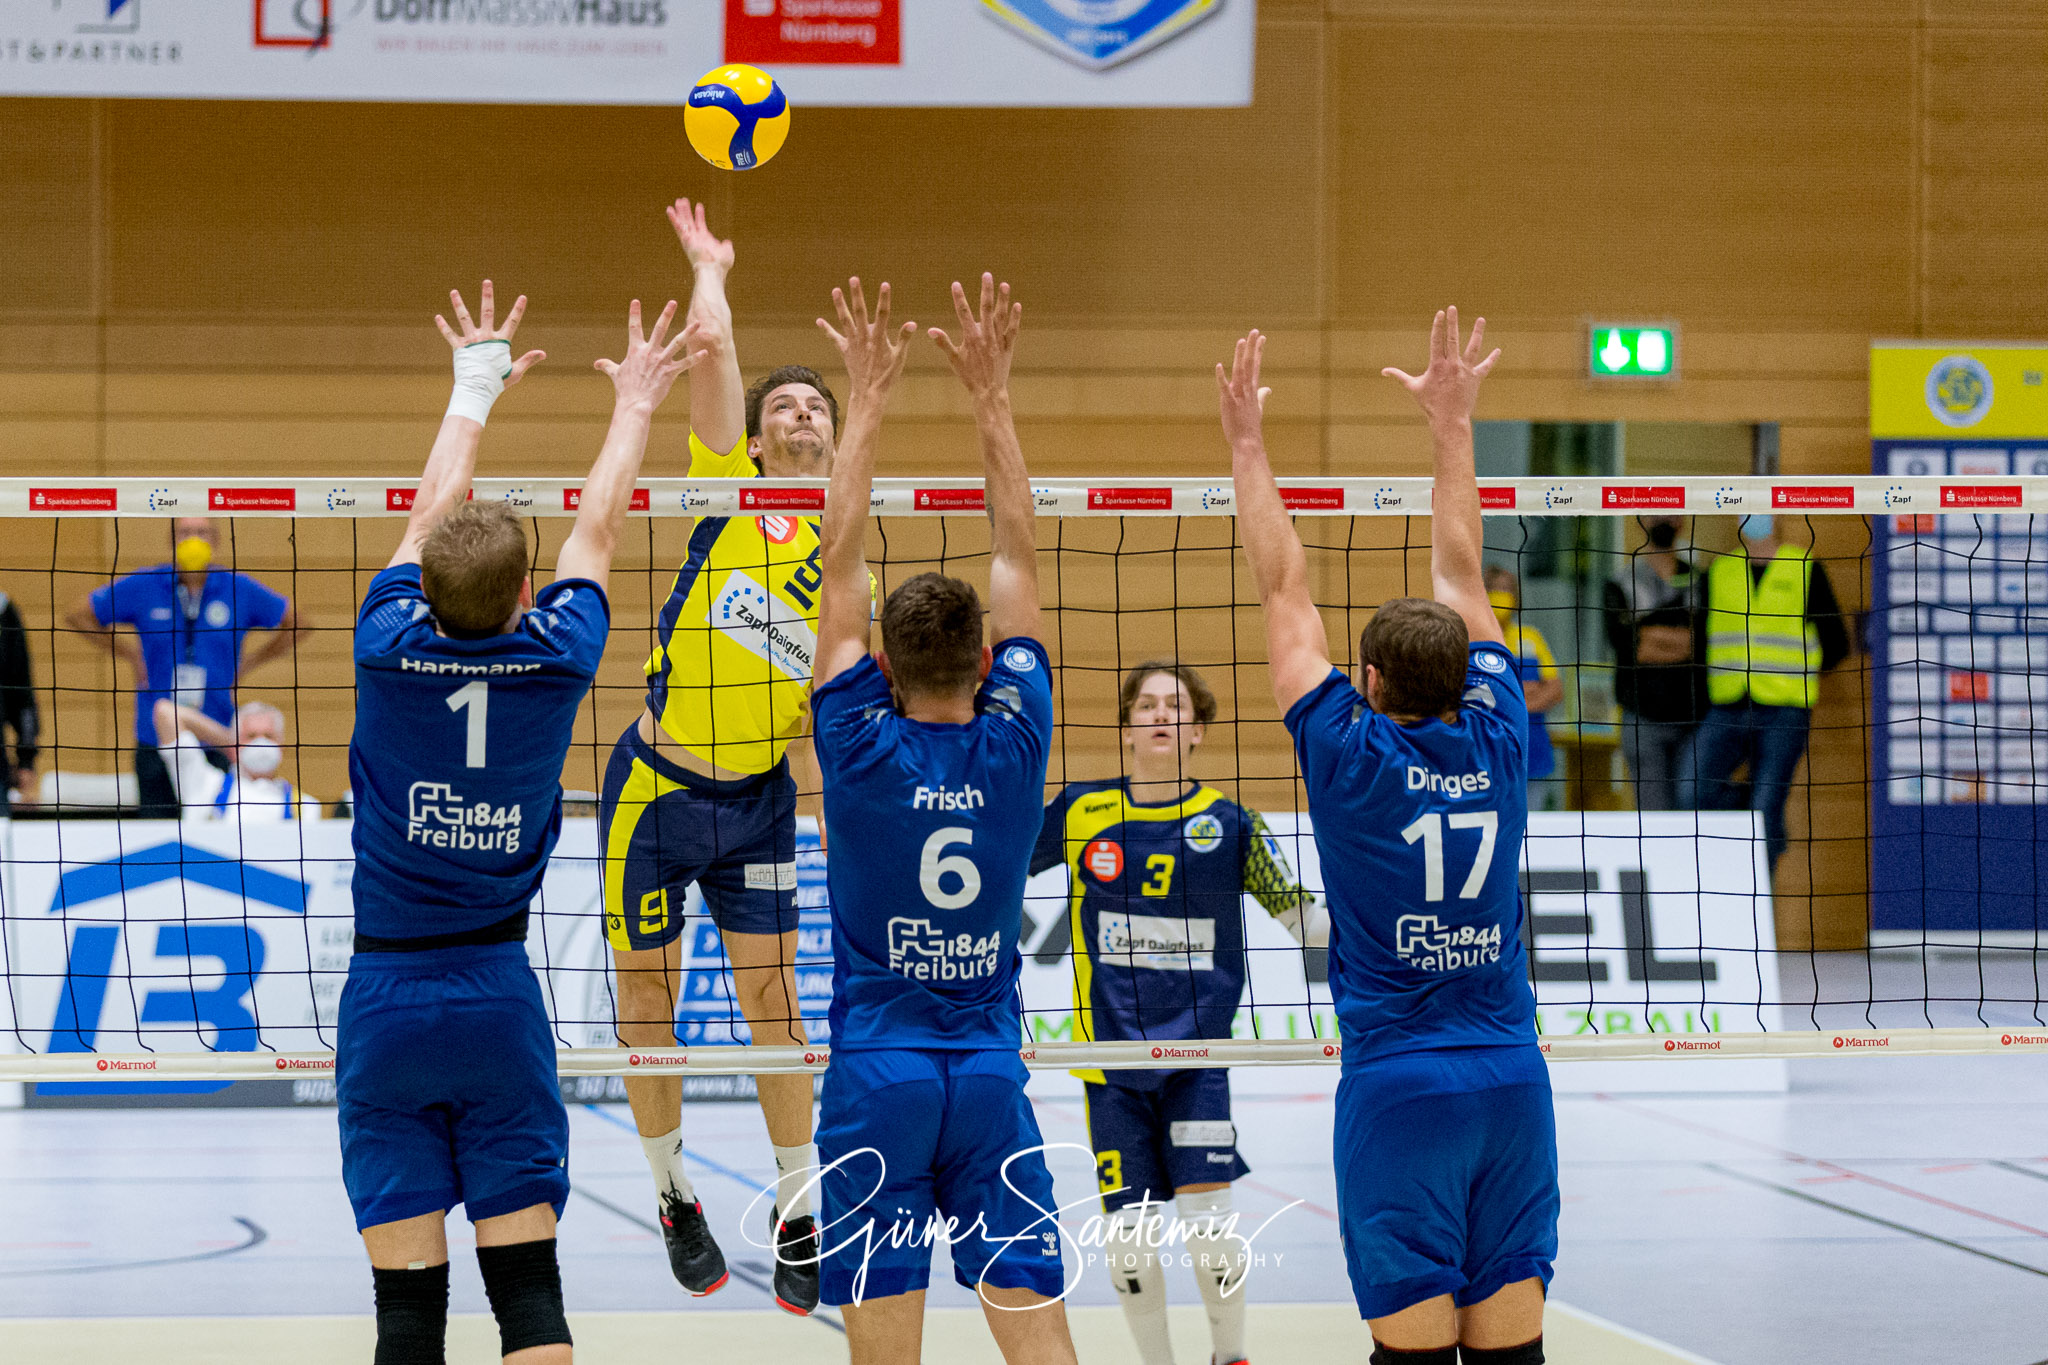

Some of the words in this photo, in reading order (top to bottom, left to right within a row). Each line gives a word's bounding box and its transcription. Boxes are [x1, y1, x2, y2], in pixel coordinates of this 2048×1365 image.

[780, 20, 877, 48] Nürnberg
[53, 41, 182, 65] PARTNER
[47, 498, 80, 507] Sparkasse
[81, 498, 111, 507] Nürnberg
[158, 498, 178, 507] Zapf
[227, 498, 259, 507] Sparkasse
[260, 498, 290, 507] Nürnberg
[336, 498, 356, 507] Zapf
[513, 498, 533, 507] Zapf
[689, 498, 709, 507] Zapf
[757, 497, 789, 506] Sparkasse
[790, 497, 820, 506] Nürnberg
[870, 498, 884, 507] apf
[932, 498, 963, 506] Sparkasse
[964, 498, 984, 506] Nürnb
[1038, 498, 1058, 506] Zapf
[1105, 498, 1137, 506] Sparkasse
[1138, 498, 1166, 506] Nürnberg
[1210, 497, 1230, 506] Zapf
[1282, 496, 1310, 505] parkasse
[1311, 496, 1339, 505] Nürnberg
[1382, 497, 1402, 505] Zapf
[1481, 496, 1510, 505] Nürnberg
[1553, 496, 1573, 504] Zapf
[1619, 496, 1651, 504] Sparkasse
[1652, 496, 1680, 504] Nürnberg
[1724, 496, 1743, 504] Zapf
[1789, 495, 1819, 504] Sparkasse
[1820, 495, 1848, 504] Nürnberg
[1892, 495, 1911, 504] Zapf
[1957, 494, 1987, 503] Sparkasse
[1988, 494, 2017, 503] Nürnberg
[735, 604, 769, 634] Zapf
[768, 626, 813, 669] Daigfus
[401, 657, 541, 676] Hartmann
[445, 680, 489, 768] 1
[1407, 766, 1491, 799] Dinges
[913, 783, 984, 810] Frisch
[466, 802, 522, 829] 1844
[407, 821, 521, 855] Freiburg
[1400, 810, 1498, 902] 17
[919, 826, 981, 910] 6
[1141, 854, 1175, 899] 3
[639, 888, 669, 935] 9
[1451, 923, 1501, 949] 1844
[947, 930, 1000, 957] 1844
[1116, 936, 1144, 950] Zapf
[1148, 939, 1205, 952] Daigfuss
[889, 951, 998, 981] Freiburg
[1845, 1038, 1890, 1047] Marmot
[2014, 1034, 2048, 1044] Marm
[1677, 1041, 1722, 1050] Marmot
[1164, 1048, 1209, 1058] Marmot
[289, 1059, 335, 1069] Marmot
[642, 1055, 688, 1065] Marmot
[110, 1060, 157, 1070] Marmot
[1096, 1149, 1123, 1195] 3
